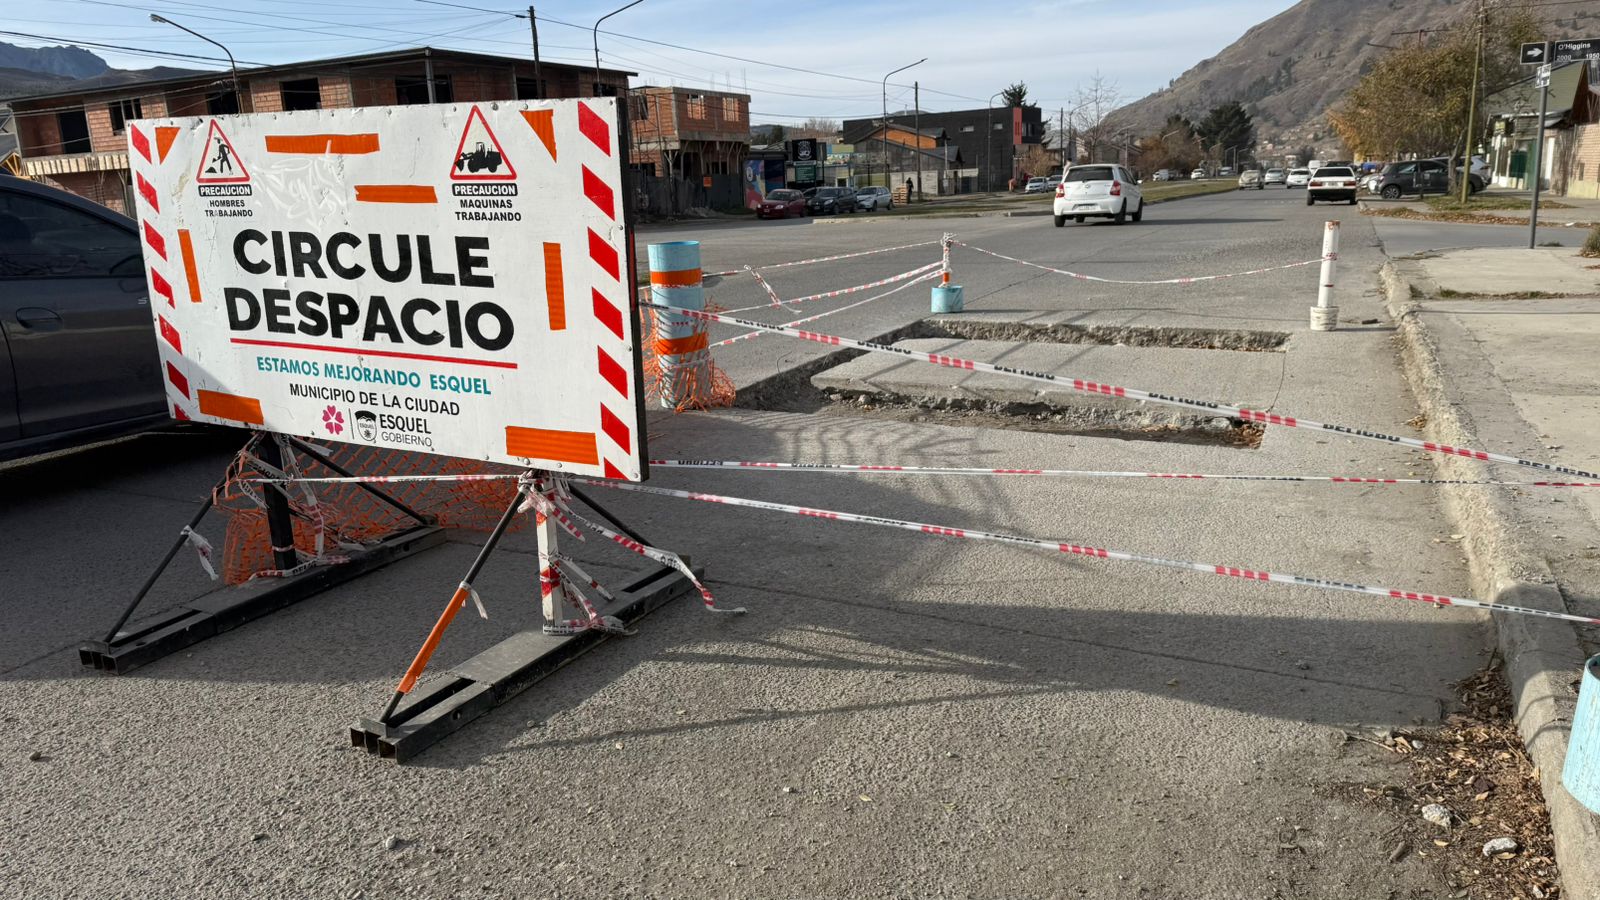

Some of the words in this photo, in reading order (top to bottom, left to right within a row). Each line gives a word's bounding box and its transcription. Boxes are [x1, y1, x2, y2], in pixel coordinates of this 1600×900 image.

[1558, 42, 1591, 51] O'Higgins
[199, 186, 251, 196] PRECAUCION
[454, 184, 516, 195] PRECAUCION
[209, 199, 245, 207] HOMBRES
[459, 199, 513, 209] MAQUINAS
[204, 209, 253, 217] TRABAJANDO
[454, 211, 522, 221] TRABAJANDO
[232, 228, 495, 288] CIRCULE
[223, 287, 515, 352] DESPACIO
[256, 356, 320, 376] ESTAMOS
[324, 363, 421, 388] MEJORANDO
[429, 374, 492, 395] ESQUEL
[289, 383, 355, 403] MUNICIPIO
[359, 391, 379, 406] DE
[382, 393, 402, 409] LA
[404, 397, 460, 416] CIUDAD
[379, 413, 432, 435] ESQUEL
[381, 431, 433, 447] GOBIERNO
